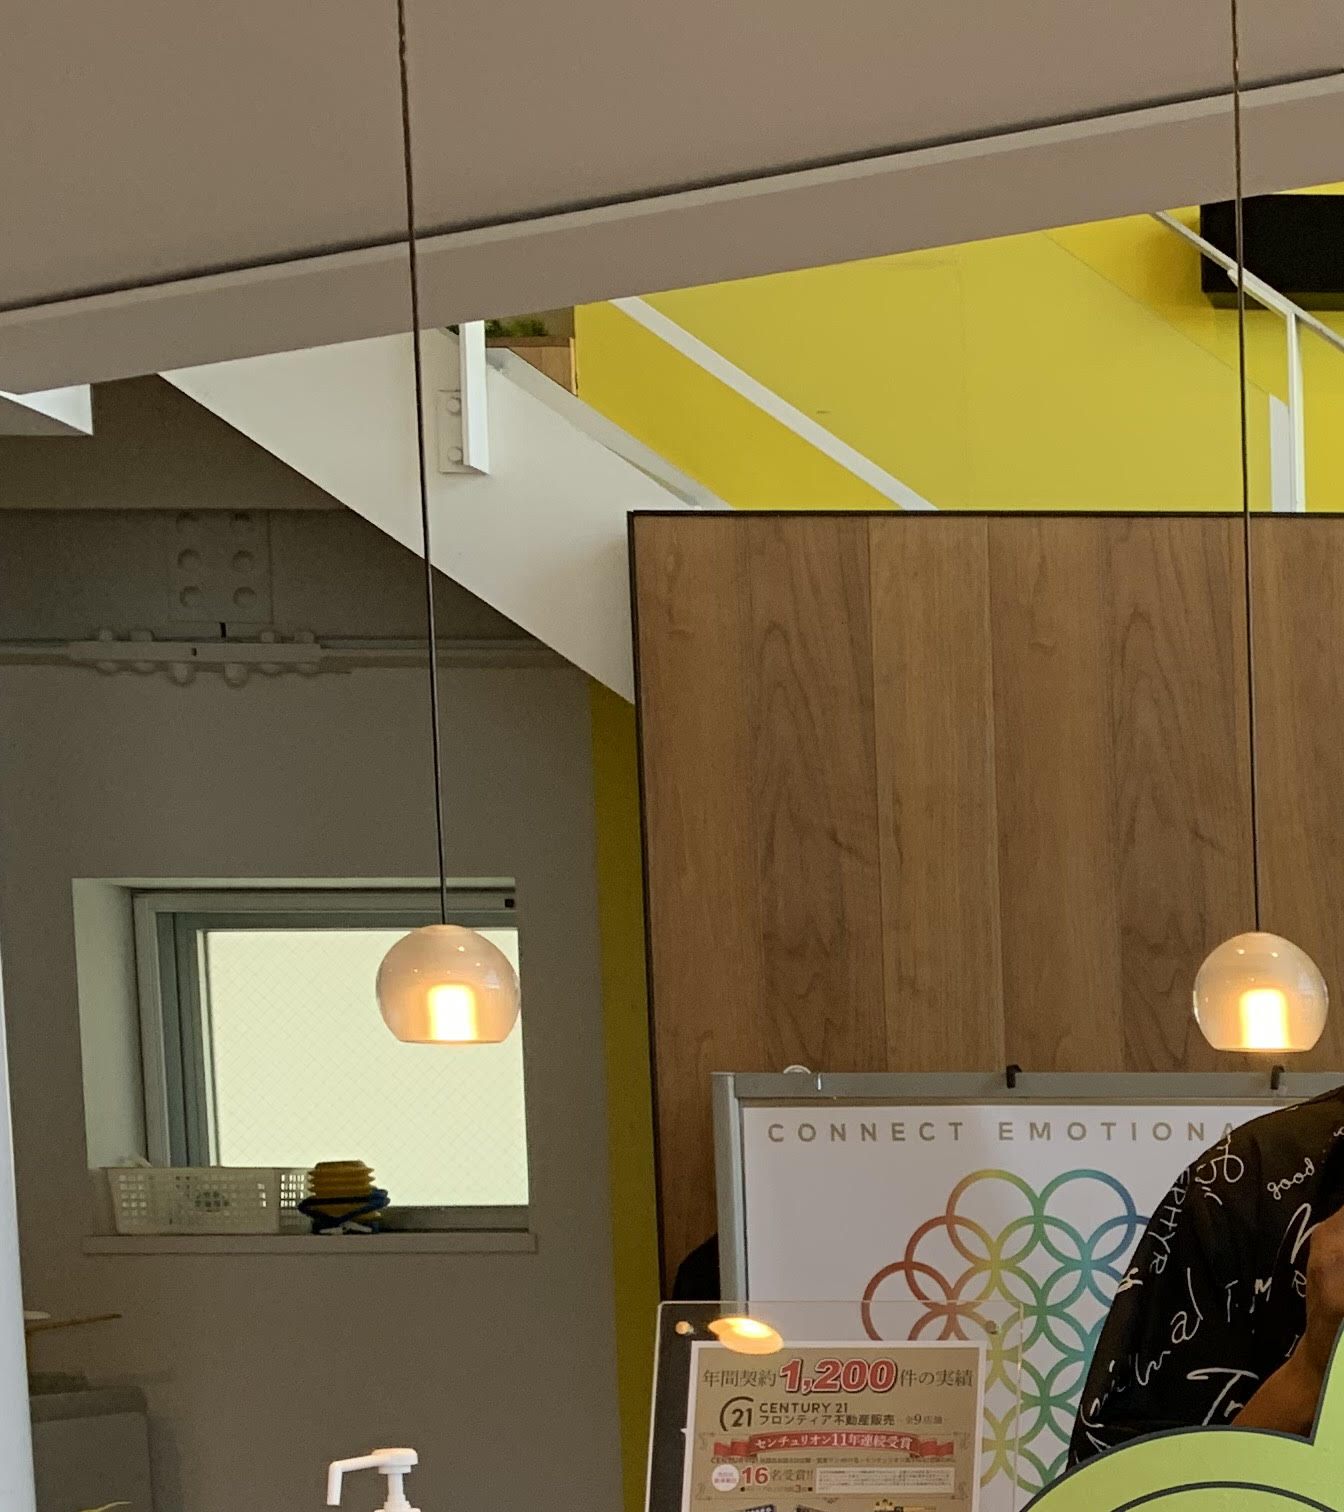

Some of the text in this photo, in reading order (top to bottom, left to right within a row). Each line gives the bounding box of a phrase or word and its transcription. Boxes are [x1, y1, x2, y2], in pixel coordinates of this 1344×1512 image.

[768, 1122, 964, 1143] CONNECT
[759, 1403, 848, 1413] CENTURY 21
